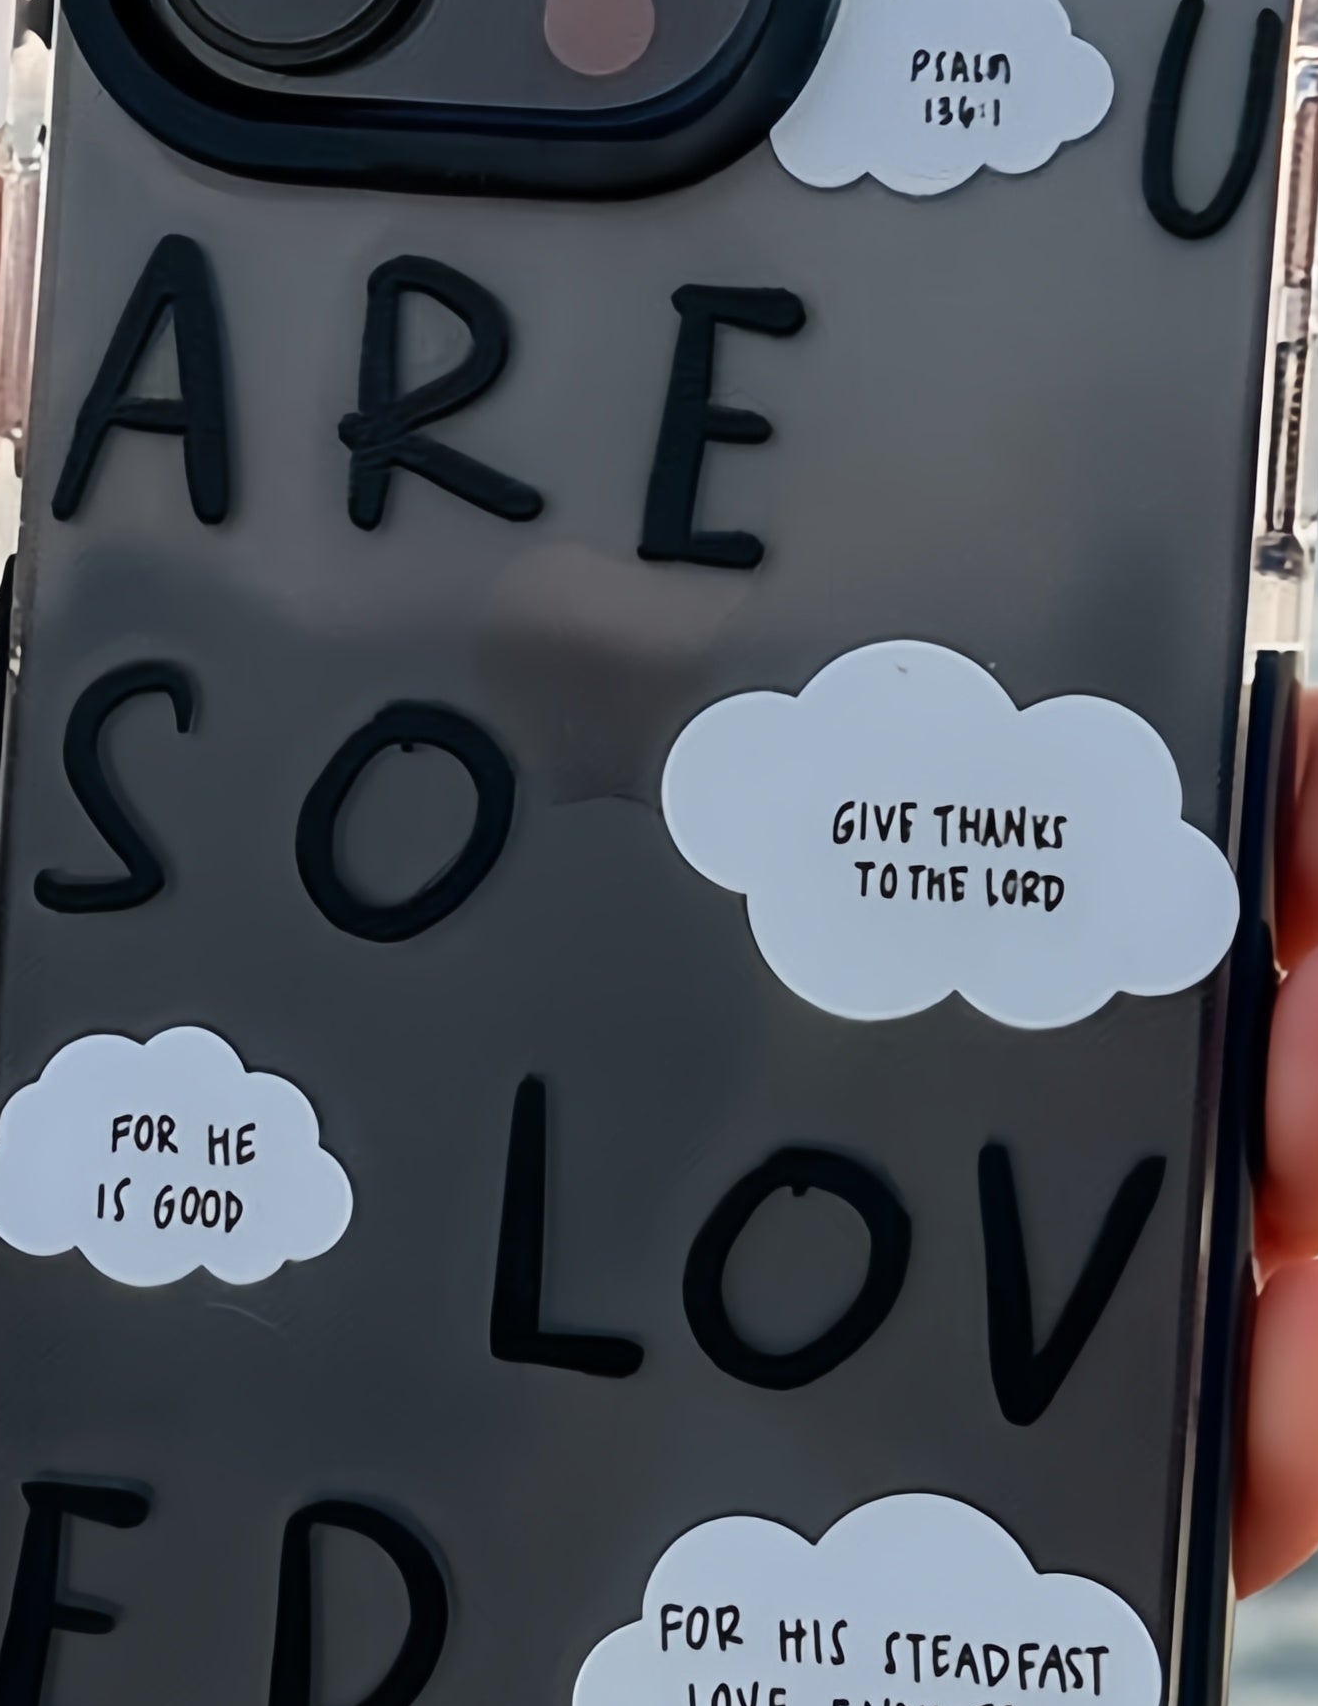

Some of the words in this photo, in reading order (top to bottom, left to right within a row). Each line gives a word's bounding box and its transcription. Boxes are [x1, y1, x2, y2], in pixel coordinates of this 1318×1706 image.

[911, 49, 1011, 84] PSALM
[925, 96, 1001, 129] 136:1
[51, 234, 807, 569] ARE
[34, 659, 516, 944] SO
[833, 801, 918, 845] GIVE
[933, 804, 1068, 849] THANKS
[854, 861, 898, 899] TO
[909, 864, 969, 903] THE
[985, 867, 1065, 912] LORD
[111, 1114, 179, 1154] FOR
[207, 1122, 256, 1166] HE
[96, 1177, 131, 1222] IS
[154, 1185, 243, 1233] GOOD
[490, 1073, 1167, 1427] LOV
[660, 1604, 744, 1652] FOR
[779, 1619, 848, 1666] HIS
[884, 1631, 1110, 1697] STEADFAST
